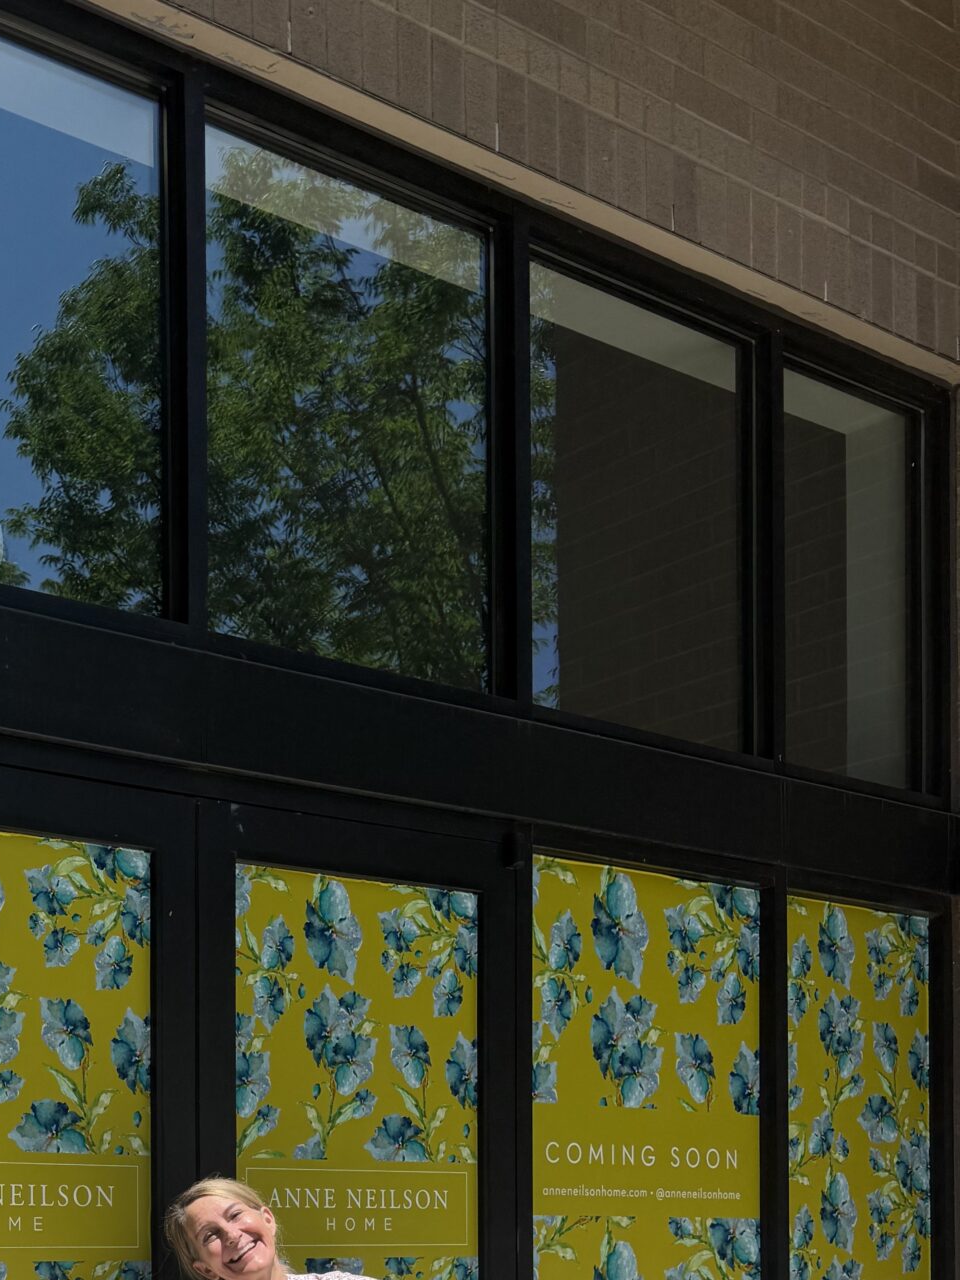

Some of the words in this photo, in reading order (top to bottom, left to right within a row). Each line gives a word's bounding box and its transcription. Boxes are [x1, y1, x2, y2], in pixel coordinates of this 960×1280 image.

[545, 1141, 657, 1168] COMING
[670, 1146, 739, 1169] SOON
[268, 1187, 337, 1209] ANNE
[346, 1188, 449, 1210] NEILSON
[542, 1184, 648, 1198] anneneilsonhome.com
[655, 1187, 741, 1201] @anneneilsonhome
[326, 1216, 393, 1232] HOME
